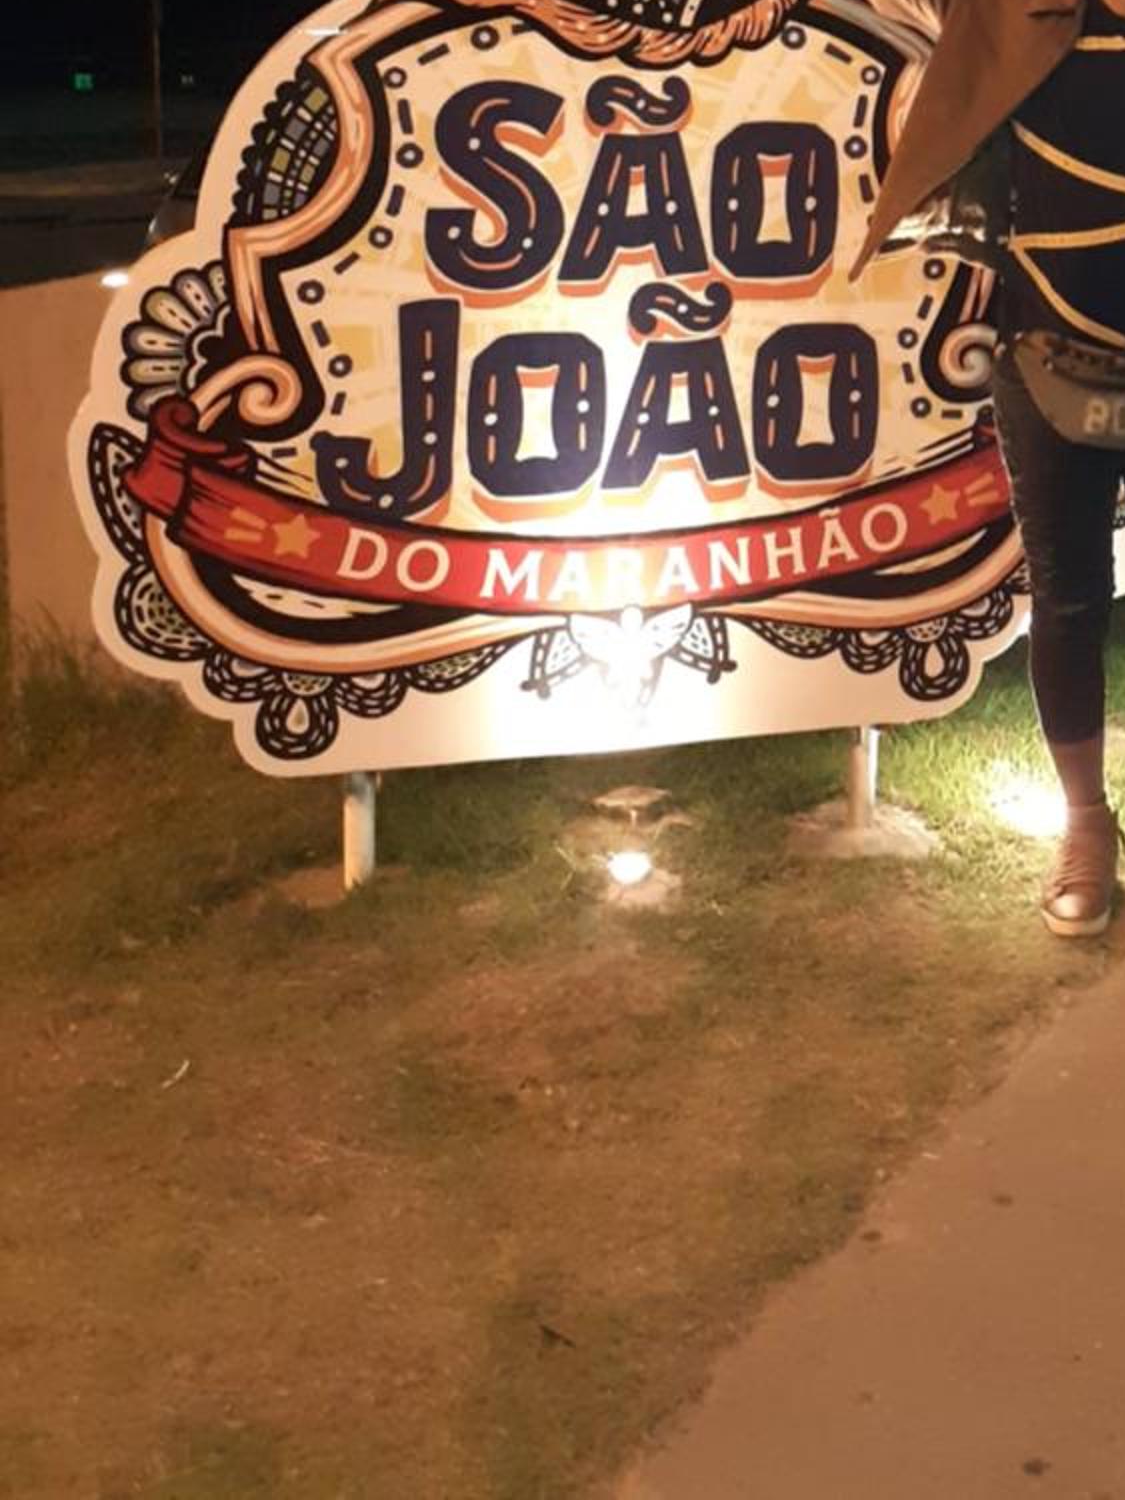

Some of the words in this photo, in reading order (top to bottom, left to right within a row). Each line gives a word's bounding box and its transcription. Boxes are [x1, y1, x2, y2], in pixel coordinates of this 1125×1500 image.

[425, 75, 839, 300] SÃO
[310, 282, 880, 521] JOÃO
[336, 527, 450, 592] DO
[479, 503, 908, 600] MARANHÃO
